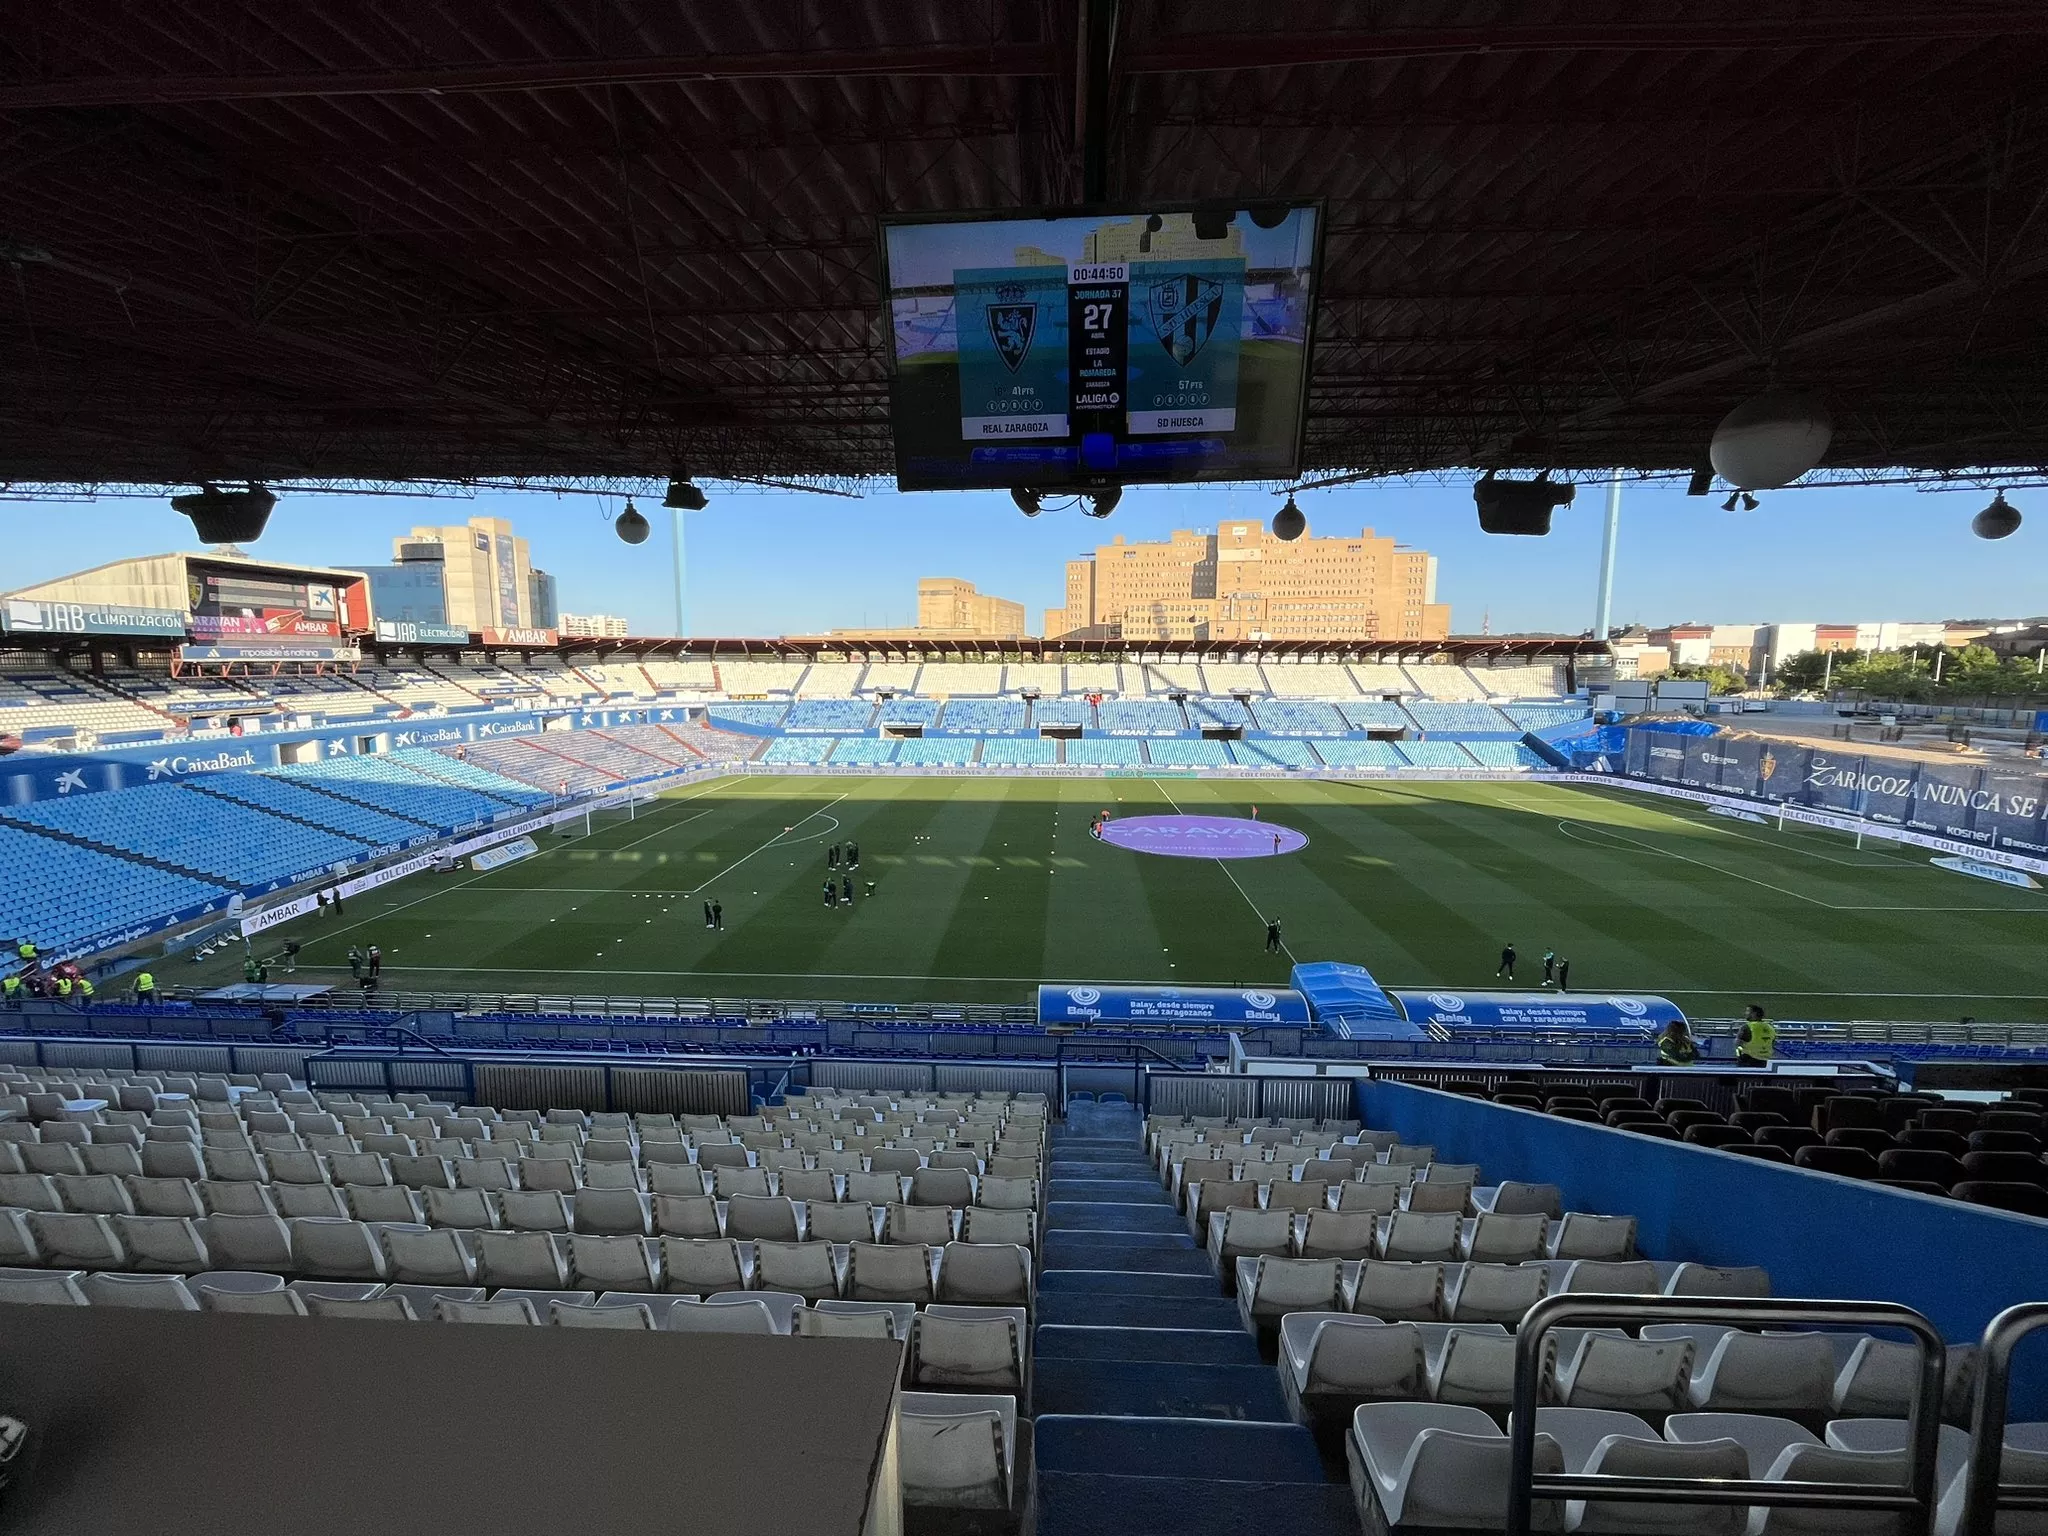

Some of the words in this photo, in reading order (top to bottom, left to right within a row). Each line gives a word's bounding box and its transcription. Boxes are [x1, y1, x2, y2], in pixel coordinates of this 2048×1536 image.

[1073, 267, 1124, 281] 00:44:50
[1074, 290, 1110, 300] JORNADA
[1112, 289, 1122, 298] 37
[1084, 304, 1113, 330] 27
[1085, 347, 1110, 355] ESTADIO
[1080, 368, 1117, 377] ROMAREDA
[1179, 380, 1189, 389] 57
[1021, 387, 1034, 395] PTS
[1076, 394, 1107, 404] LALIGA
[982, 425, 1003, 434] REAL
[1005, 423, 1049, 433] ZARAGOZA
[1157, 418, 1169, 428] SD
[1171, 417, 1204, 427] HUESCA
[45, 602, 85, 631] JAB
[89, 613, 182, 628] CLIMATIZACIÓN
[294, 621, 329, 633] AMBAR
[397, 622, 417, 642] JAB
[420, 628, 466, 639] ELECTRICIDAD
[507, 630, 549, 644] AMBAR
[239, 649, 282, 658] impossible
[283, 648, 290, 657] is
[290, 649, 319, 658] nothing
[491, 719, 535, 734] CaixaBank
[411, 727, 463, 744] CaixaBank
[171, 750, 255, 775] CaixaBank
[1710, 754, 1739, 765] Zaragoza
[1565, 775, 1612, 784] COLCHONES
[1803, 757, 1919, 799] ZARAGOZA
[1923, 783, 2000, 812] NUNCA
[2007, 795, 2038, 818] SE
[1670, 789, 1717, 803] COLCHONES
[1872, 813, 1901, 824] embou
[1906, 820, 1937, 831] embou
[497, 821, 542, 840] COLCHONES
[1105, 825, 1291, 836] CARAVAN
[1933, 839, 2013, 864] COLCHONES
[296, 866, 325, 882] AMBAR
[375, 854, 435, 884] COLCHONES
[259, 903, 300, 928] AMBAR
[1067, 1006, 1102, 1018] Balay
[1130, 1001, 1153, 1010] Balay,
[1156, 1001, 1181, 1009] desde
[1182, 1002, 1215, 1011] siempre
[1146, 1008, 1159, 1016] los
[1161, 1009, 1213, 1017] zaragozanos
[1245, 1010, 1280, 1022] Balay
[1435, 1013, 1472, 1024] Balay
[1499, 1008, 1526, 1017] Balay,
[1527, 1008, 1551, 1016] desde
[1553, 1009, 1587, 1018] siempre
[1533, 1016, 1587, 1025] zaragozanos
[1620, 1017, 1657, 1029] Balay
